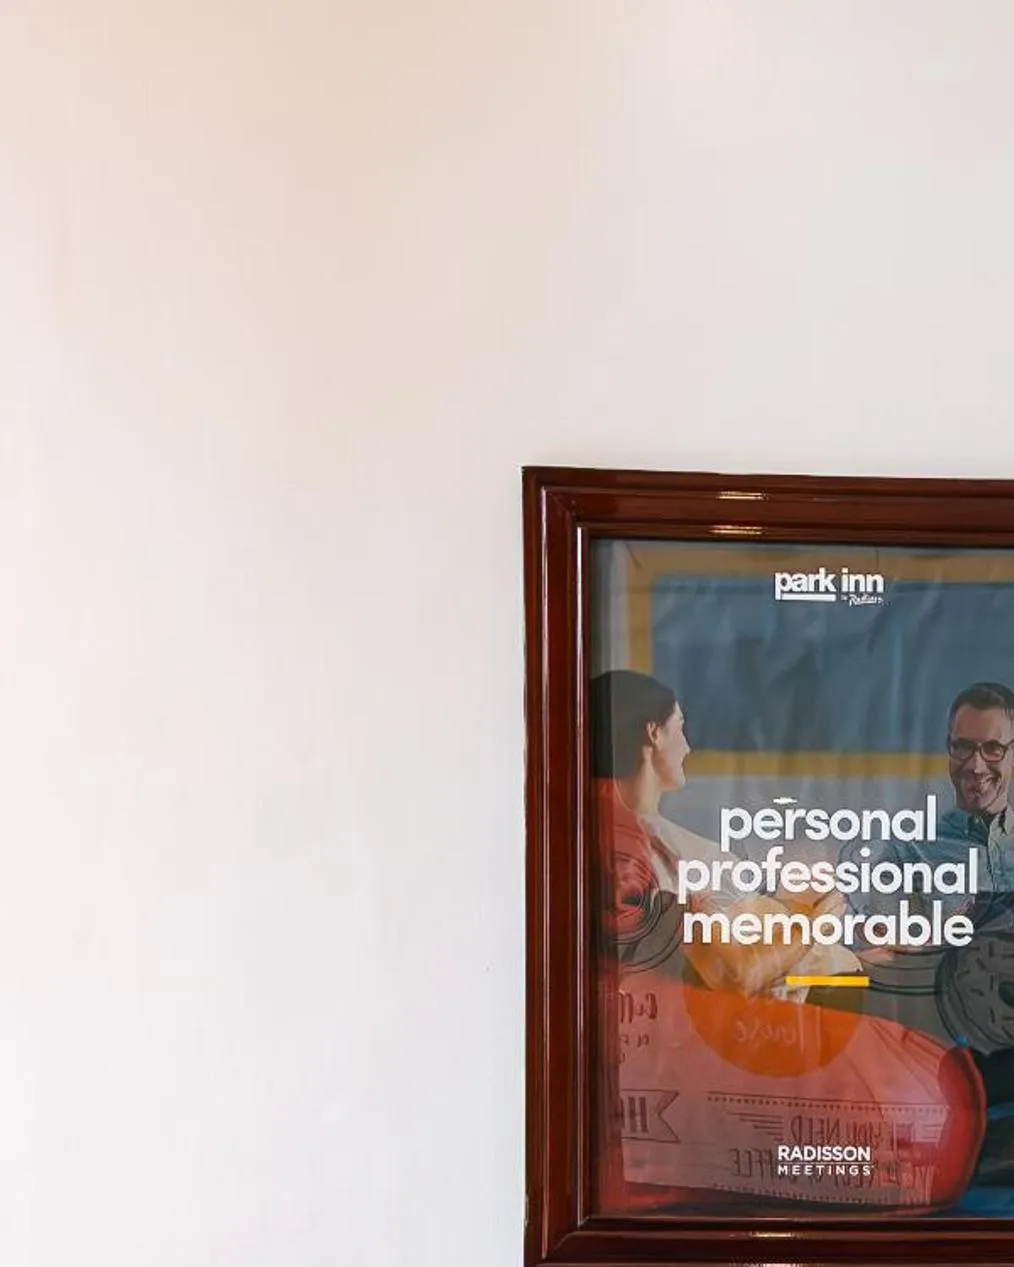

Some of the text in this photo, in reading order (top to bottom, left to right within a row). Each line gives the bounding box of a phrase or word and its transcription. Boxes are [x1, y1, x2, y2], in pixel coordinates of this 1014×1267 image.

[774, 567, 837, 602] park
[841, 567, 884, 593] inn
[720, 795, 937, 852] personal
[678, 847, 979, 904] professional
[682, 900, 974, 947] memorable
[777, 1145, 871, 1162] RADISSON
[777, 1164, 871, 1176] MEETINGS
